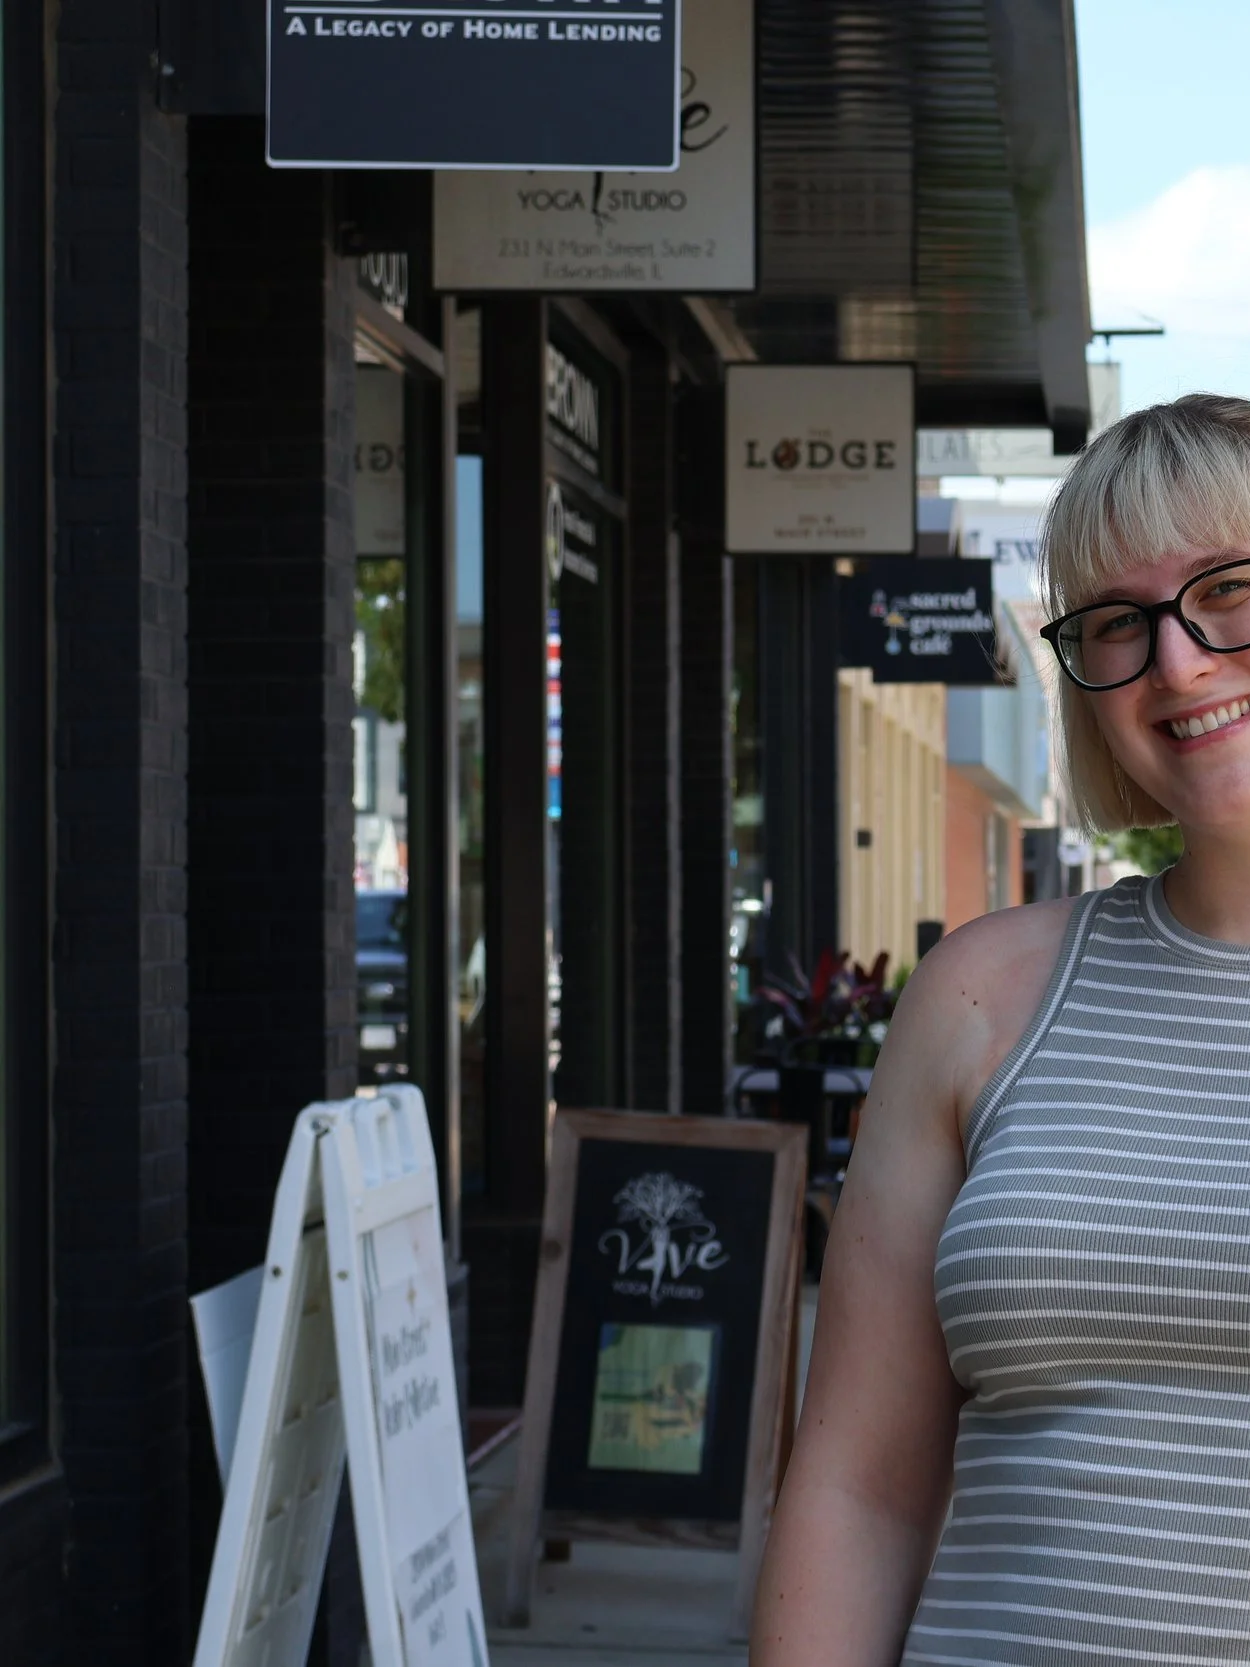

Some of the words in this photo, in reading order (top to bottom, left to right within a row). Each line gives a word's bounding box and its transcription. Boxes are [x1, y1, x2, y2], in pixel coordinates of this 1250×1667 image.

[286, 16, 307, 36] A
[518, 189, 585, 211] YOGA
[608, 189, 687, 213] STUDIO
[559, 239, 601, 257] Main
[662, 239, 701, 258] Suite
[706, 239, 717, 258] 2
[744, 437, 897, 471] LODGE
[909, 588, 977, 609] sacred
